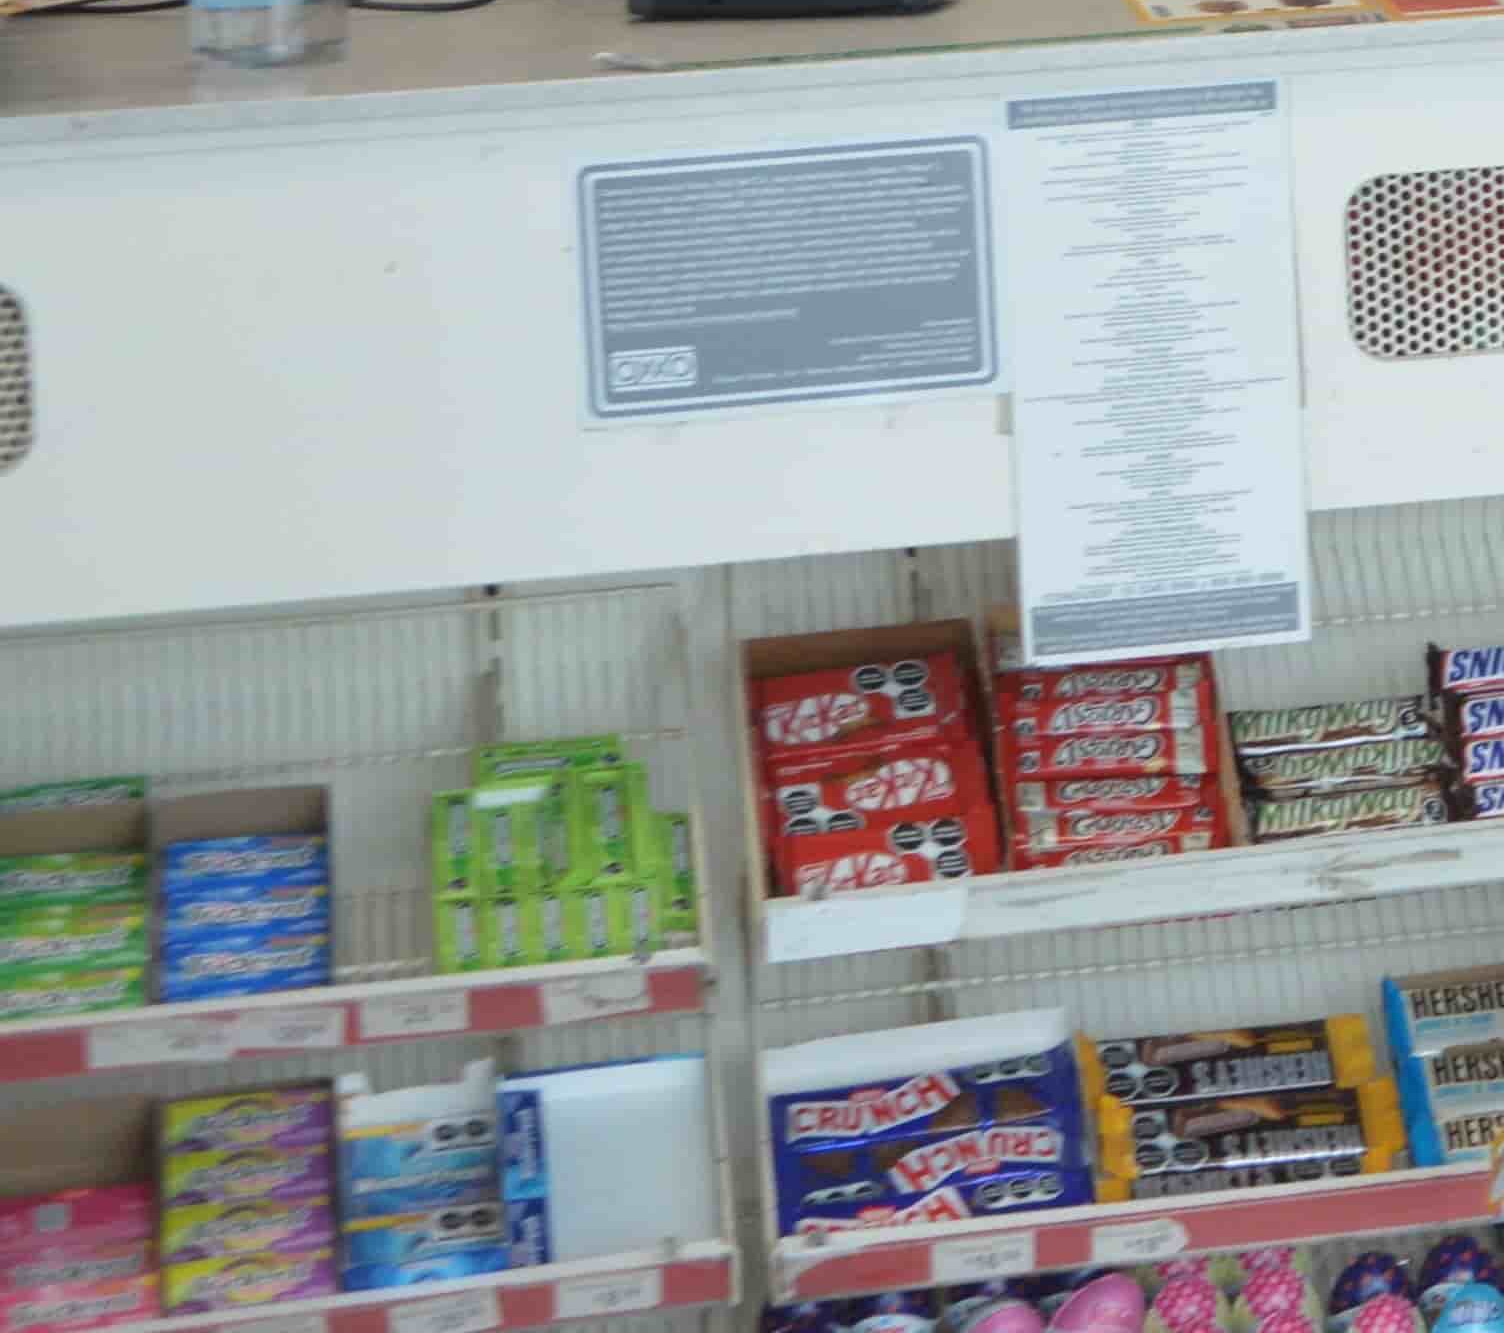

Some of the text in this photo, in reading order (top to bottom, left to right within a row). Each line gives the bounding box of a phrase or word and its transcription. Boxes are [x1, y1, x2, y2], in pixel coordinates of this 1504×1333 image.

[609, 351, 697, 390] OXXO
[790, 1074, 960, 1142] CRUNCH
[893, 1124, 1065, 1192] CRUNCH
